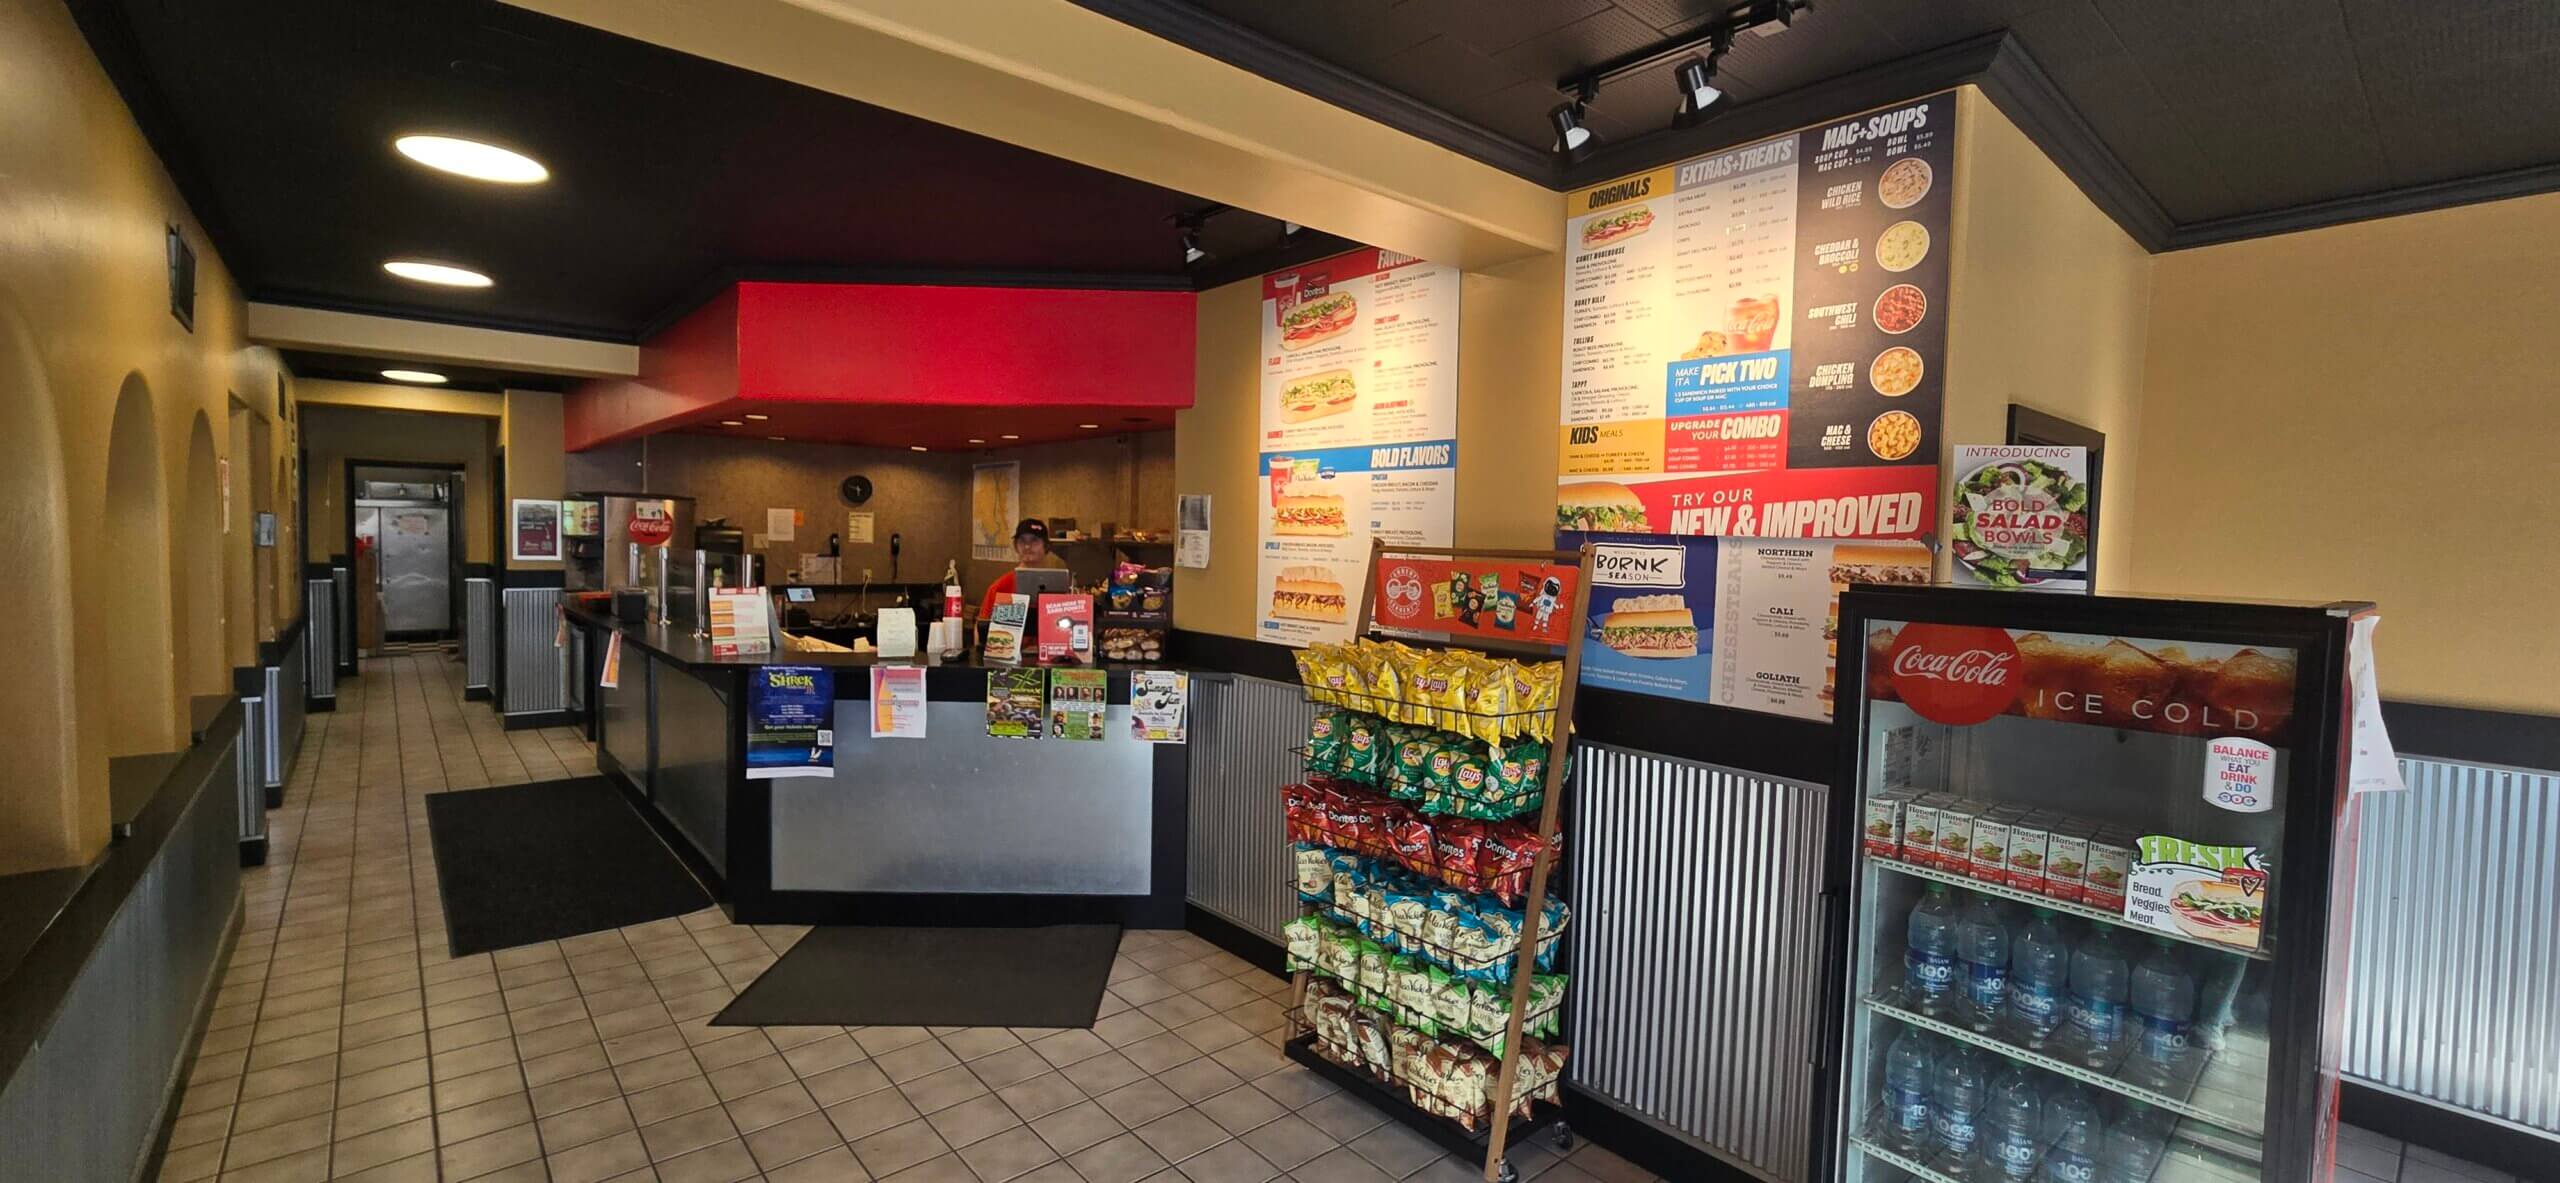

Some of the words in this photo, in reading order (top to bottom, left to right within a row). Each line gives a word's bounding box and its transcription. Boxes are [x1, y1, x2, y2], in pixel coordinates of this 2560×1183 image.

[1822, 104, 1929, 152] MAC+SOUPS
[1834, 149, 1849, 160] CUP
[1680, 140, 1793, 187] EXTRAS+TREATS
[1588, 178, 1650, 210] ORIGINALS
[1827, 181, 1862, 197] CHICKEN
[1822, 196, 1842, 209] WILD
[1842, 192, 1862, 204] RICE
[1814, 240, 1852, 255] CHEDDAR
[1818, 248, 1859, 265] BROCCOLI
[1808, 302, 1858, 320] SOUTHWEST
[1834, 313, 1857, 326] CHILI
[1676, 366, 1700, 377] MAKE
[1700, 362, 1738, 386] PICK
[1740, 357, 1778, 382] TWO
[1816, 362, 1854, 376] CHICKEN
[1809, 373, 1854, 388] DUMPLING
[1671, 420, 1720, 431] UPGRADE
[1720, 414, 1782, 440] COMBO
[1826, 425, 1844, 436] MAC
[1844, 424, 1852, 434] &
[1570, 426, 1598, 445] KIDS
[1600, 430, 1624, 438] MEALS
[1691, 431, 1720, 440] YOUR
[1821, 434, 1852, 446] CHEESE
[1371, 448, 1398, 468] BOLD
[1400, 444, 1450, 466] FLAVORS
[1966, 448, 2071, 458] INTRODUCING
[1672, 491, 1705, 506] TRY
[1713, 488, 1753, 504] OUR
[1992, 500, 2044, 512] BOLD
[1670, 506, 1734, 538] NEW
[1738, 507, 1756, 538] &
[1762, 492, 1922, 539] IMPROVED
[1976, 513, 2062, 530] SALAD
[629, 520, 671, 533] Coca-Cola
[1984, 530, 2054, 544] BOWLS
[1757, 548, 1814, 558] NORTHERN
[1596, 554, 1668, 573] BORNK
[1608, 572, 1650, 581] SEASON
[1770, 607, 1794, 616] CALI
[1722, 538, 1742, 704] CHEESESTEAKS
[1893, 645, 2016, 686] Coca-Cola
[768, 672, 813, 688] SHREK
[1756, 672, 1800, 684] GOLIATH
[2038, 688, 2103, 714] ICE
[2132, 699, 2259, 730] COLD
[2213, 744, 2269, 760] BALANCE
[2228, 762, 2250, 774] EAT
[2220, 771, 2257, 784] DRINK
[2224, 781, 2232, 791] &
[2235, 783, 2252, 794] DO
[2012, 828, 2046, 840] Honest
[2052, 836, 2086, 848] Honest
[1438, 840, 1464, 858] oritos
[1484, 838, 1518, 861] Doritos
[2091, 844, 2127, 856] Honest
[2142, 836, 2244, 870] FRESH
[2132, 882, 2164, 898] Bread.
[2132, 896, 2172, 915] Veggies.
[2130, 910, 2156, 926] Meat.
